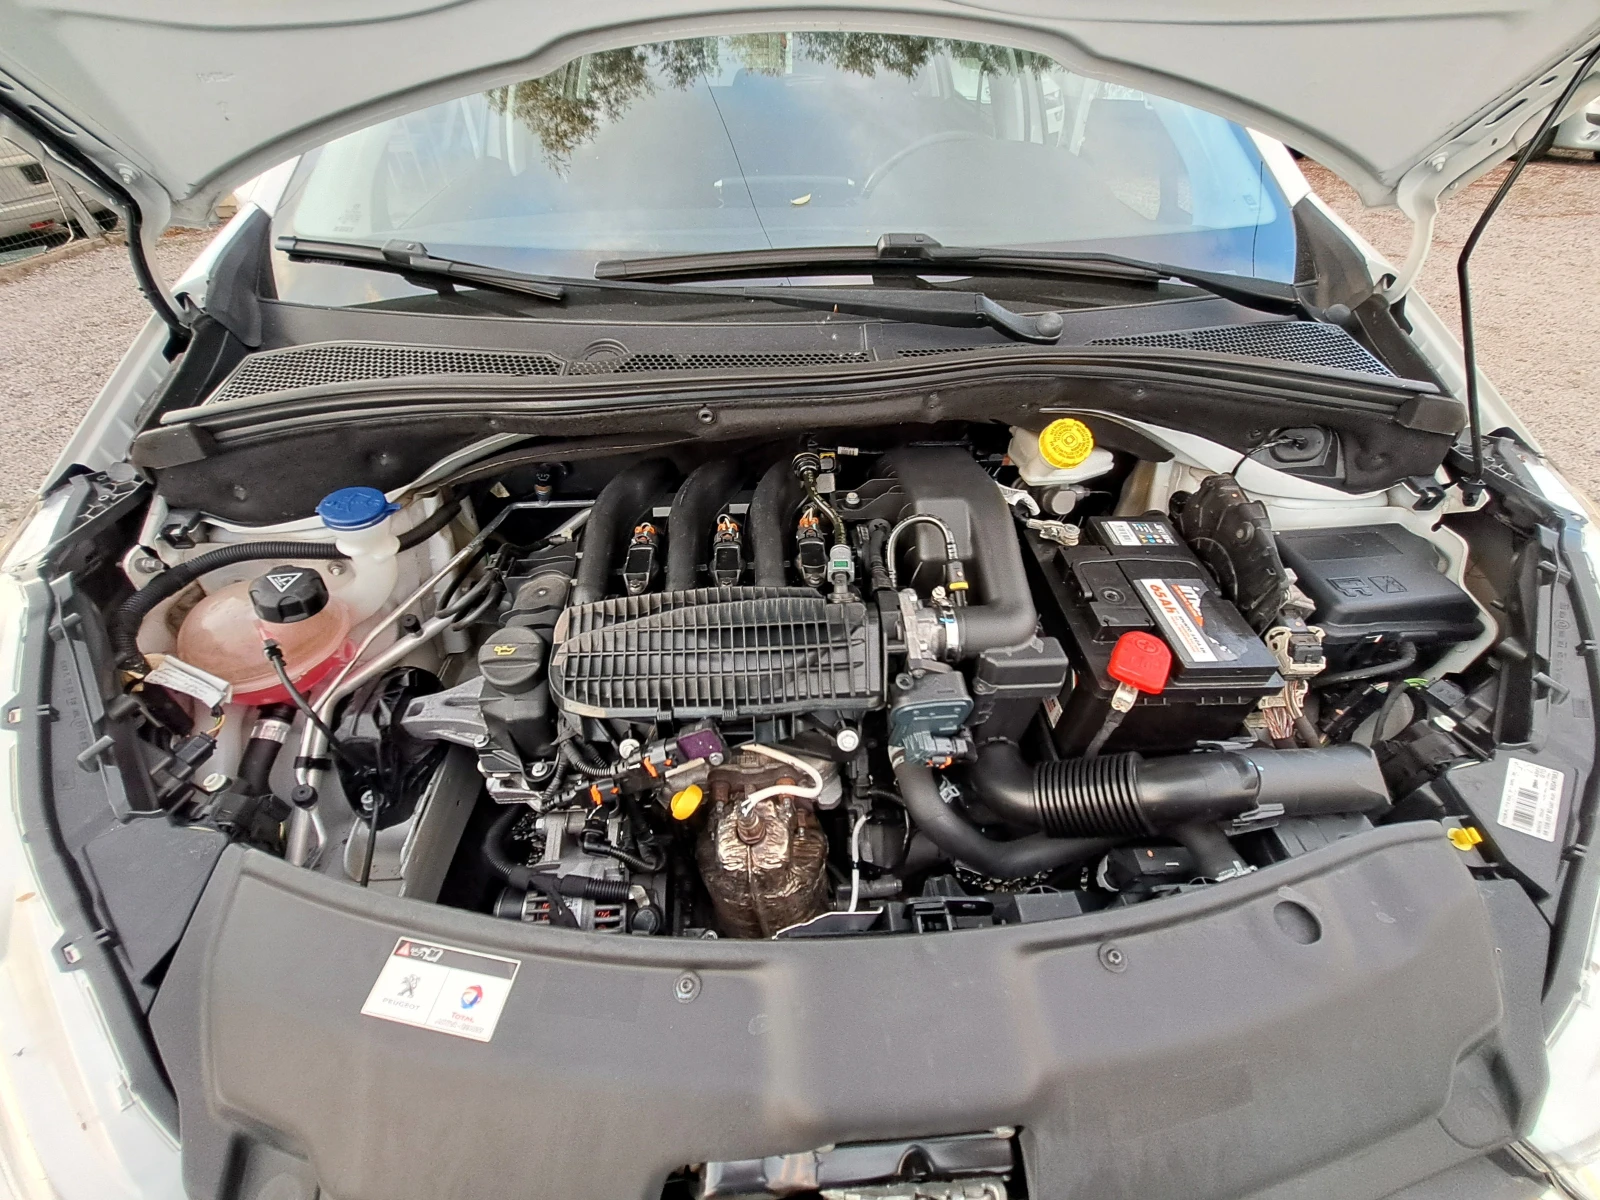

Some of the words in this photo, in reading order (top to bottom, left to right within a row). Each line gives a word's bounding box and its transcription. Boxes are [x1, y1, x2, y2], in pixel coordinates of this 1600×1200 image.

[1149, 584, 1176, 613] 65Ah
[382, 997, 421, 1011] PEUGEOT
[451, 1011, 475, 1024] TOTAL
